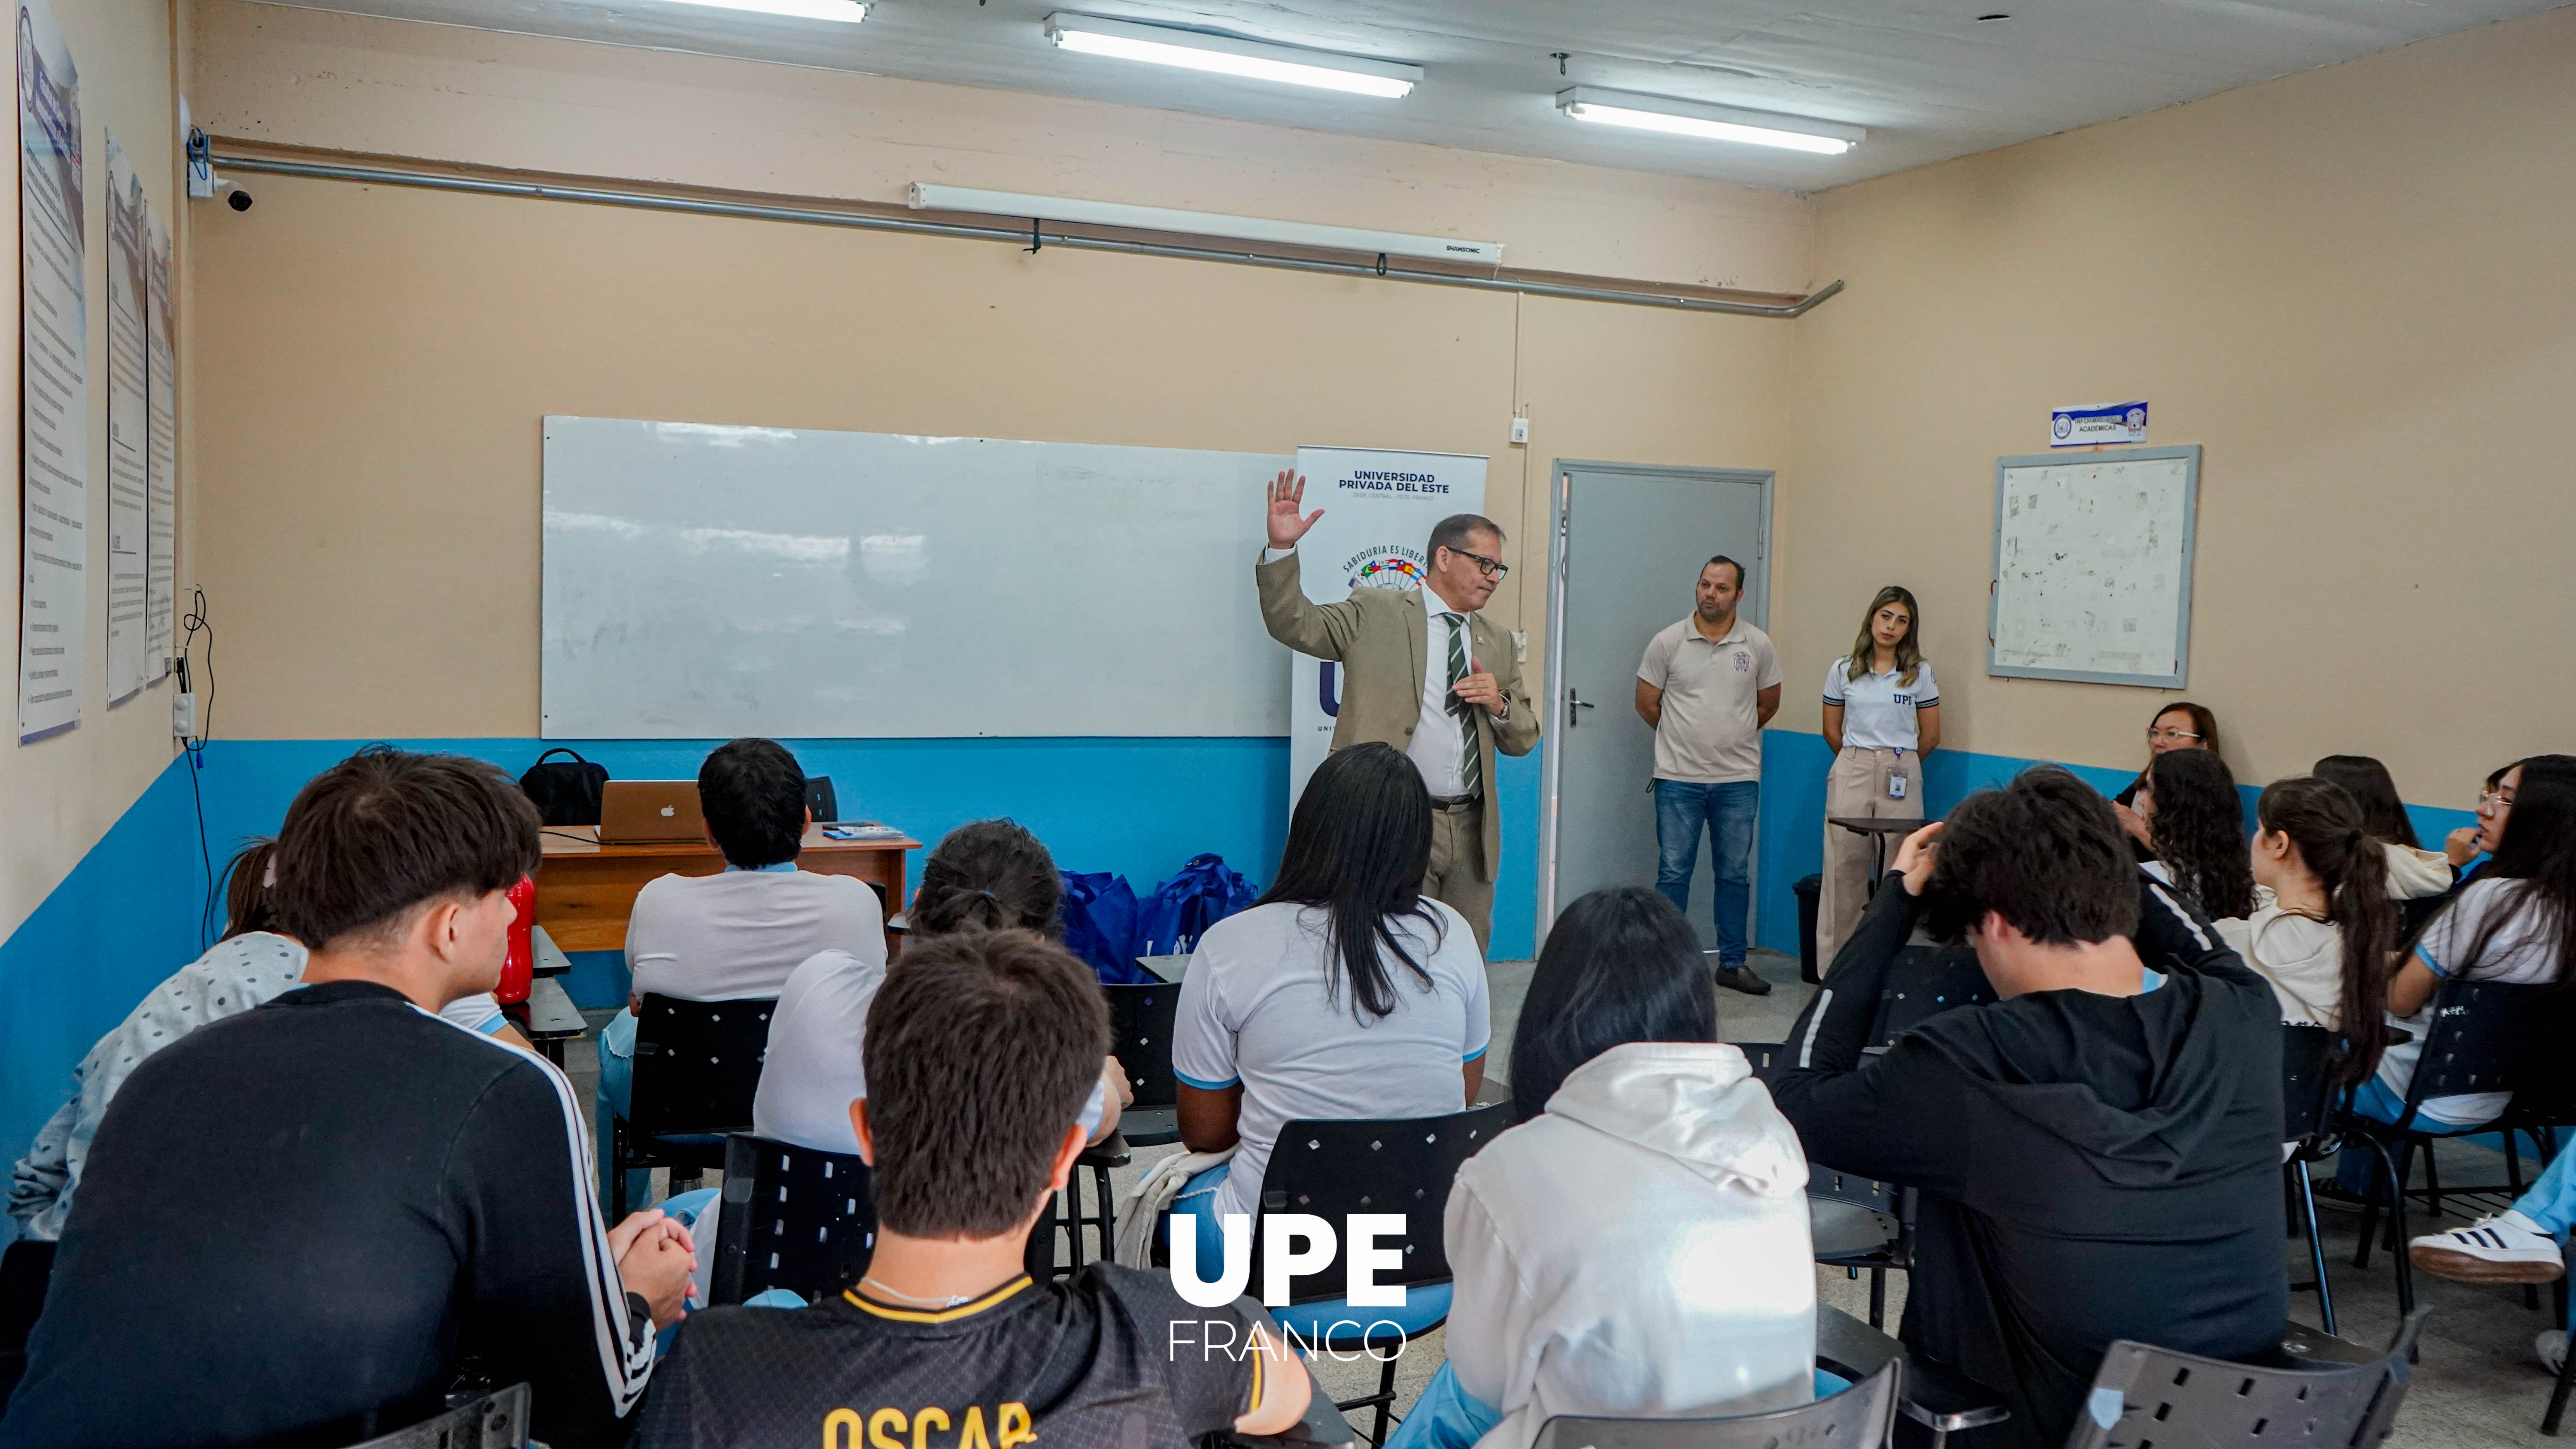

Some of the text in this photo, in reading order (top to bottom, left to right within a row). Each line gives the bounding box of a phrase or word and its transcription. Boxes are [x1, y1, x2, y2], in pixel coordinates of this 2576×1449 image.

[1355, 471, 1434, 483] UNIVERSIDAD
[1339, 480, 1449, 493] PRIVADA DEL ESTE
[1343, 546, 1387, 573] SABIDURIA
[1390, 545, 1399, 554] ES
